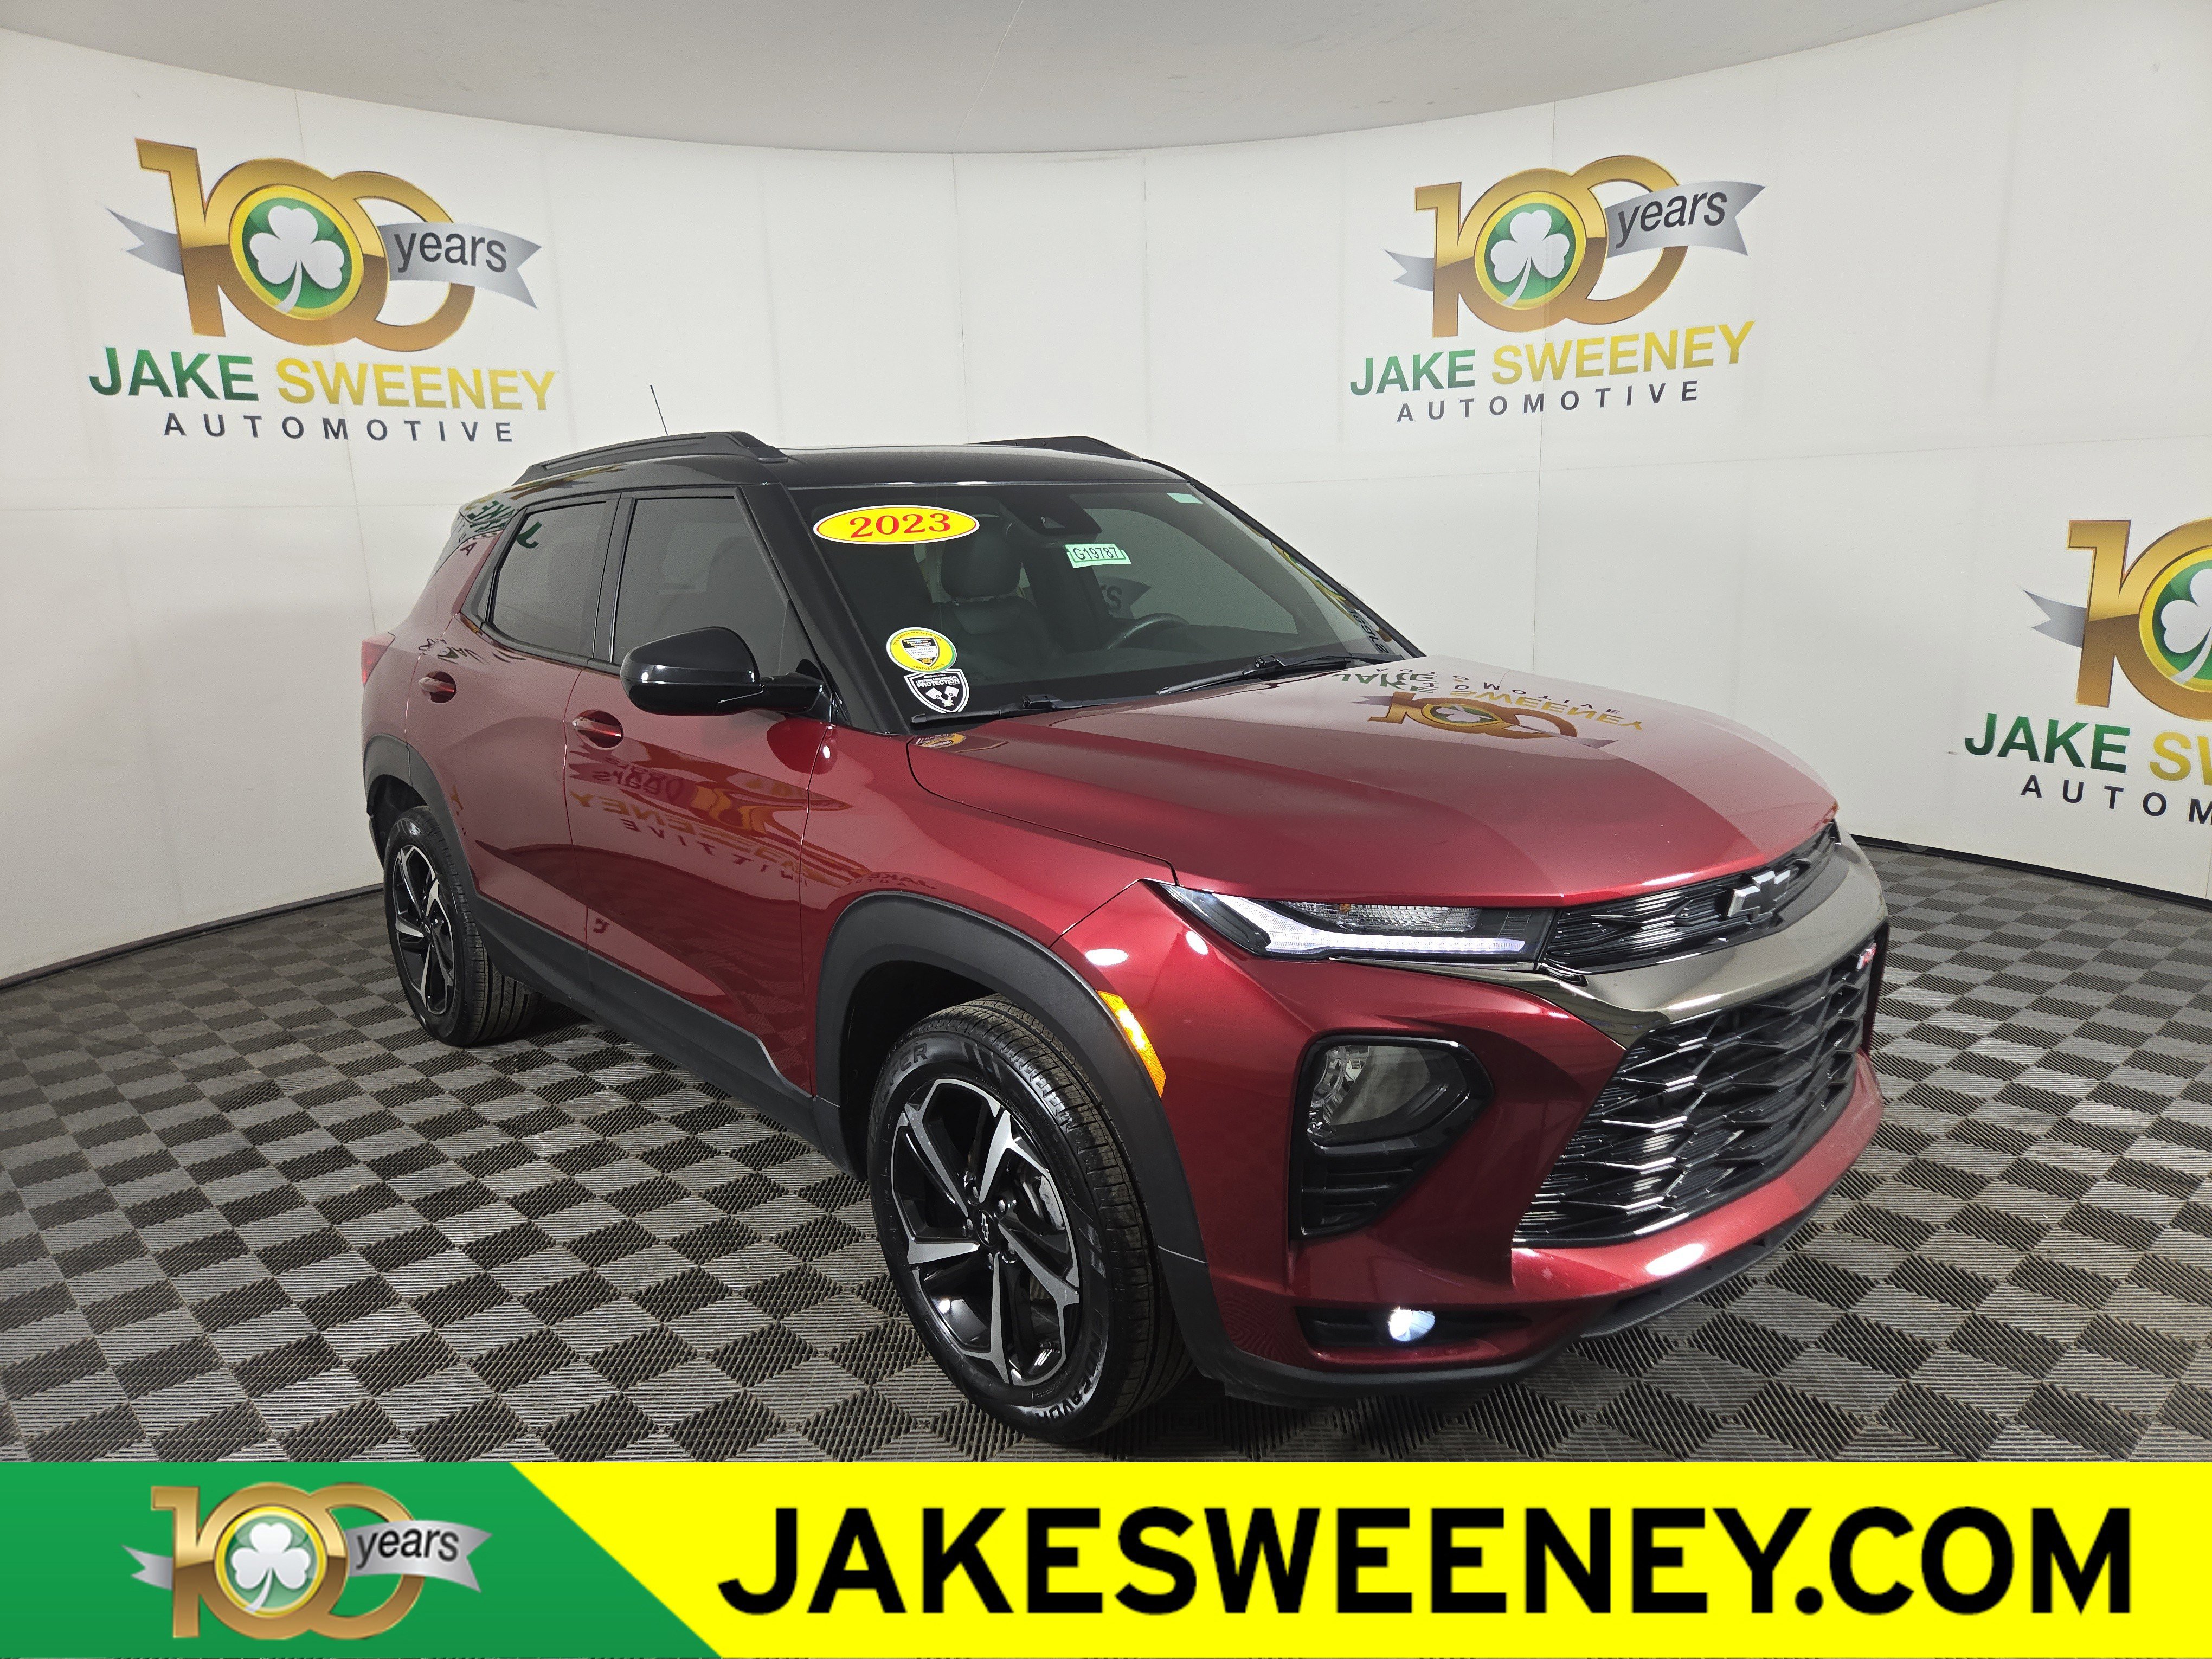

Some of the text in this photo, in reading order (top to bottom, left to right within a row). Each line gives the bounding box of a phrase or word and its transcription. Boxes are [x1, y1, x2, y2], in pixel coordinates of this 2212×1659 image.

[1616, 189, 1727, 249] years
[134, 138, 475, 352] 100
[394, 232, 507, 274] years
[1414, 154, 1688, 337] 100
[89, 346, 556, 411] JAKE SWEENEY
[1349, 320, 1756, 396] JAKE SWEENEY
[163, 411, 513, 443] AUTOMOTIVE
[1397, 380, 1699, 423] AUTOMOTIVE
[849, 513, 951, 538] 2023
[1073, 547, 1118, 560] G19787
[916, 678, 960, 687] PROTECTION
[1965, 712, 2130, 774] JAKE
